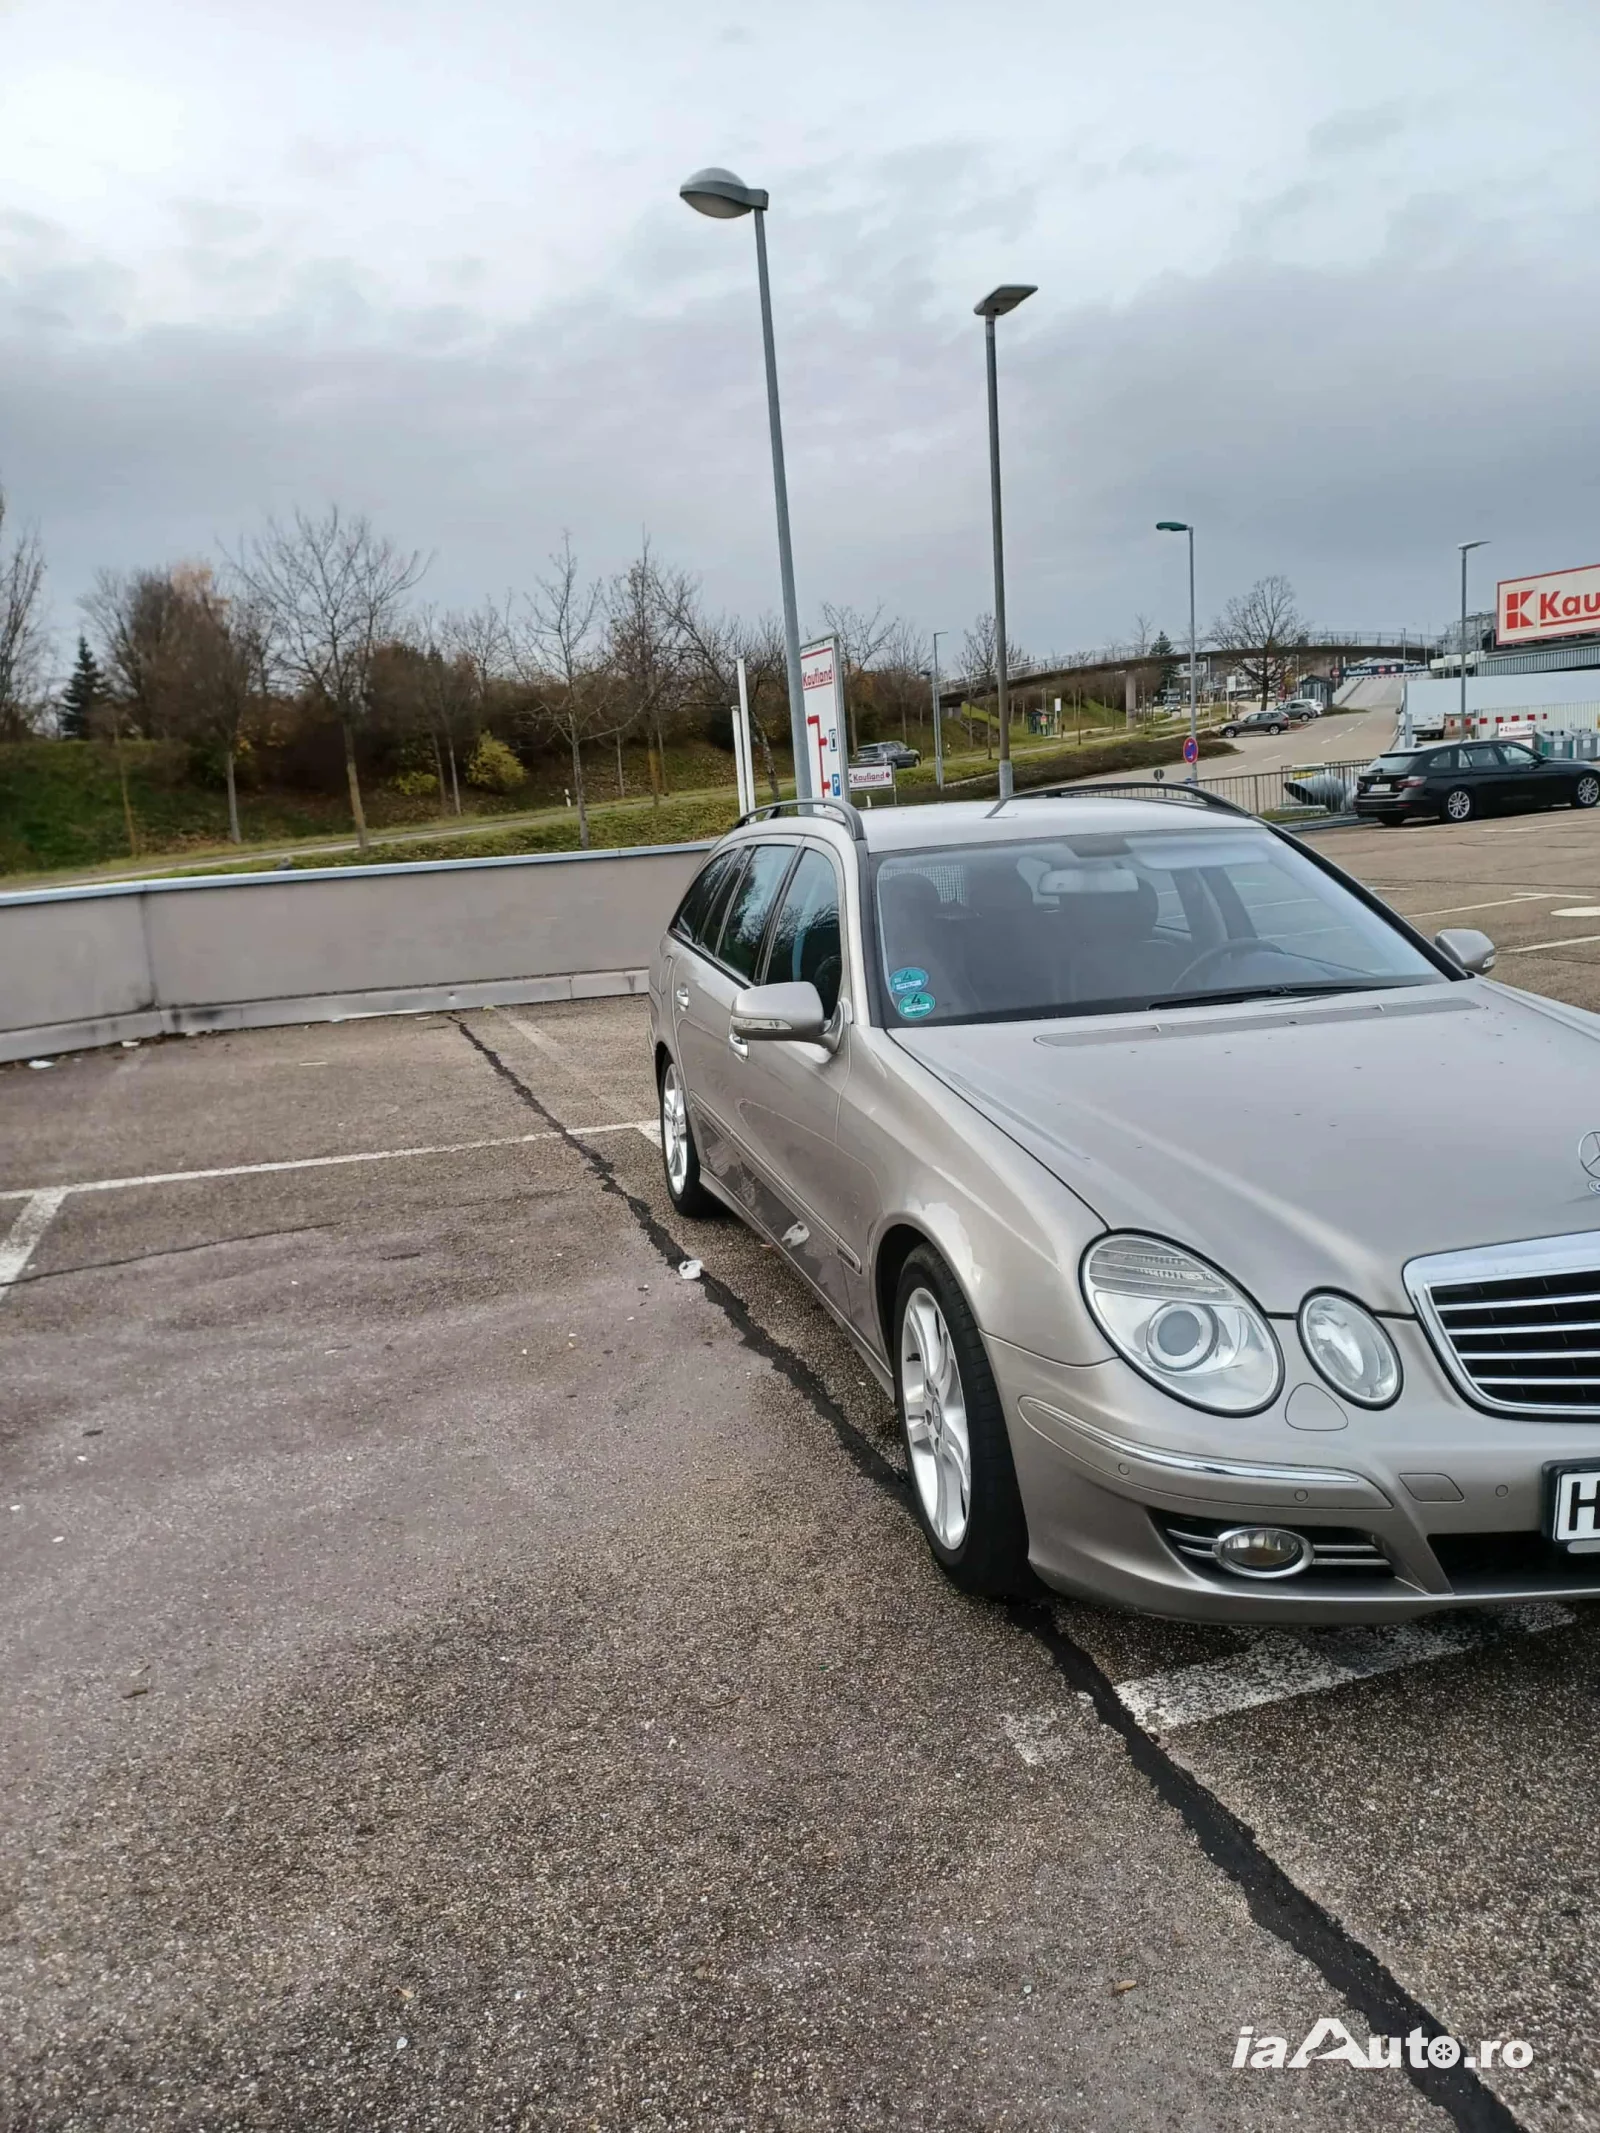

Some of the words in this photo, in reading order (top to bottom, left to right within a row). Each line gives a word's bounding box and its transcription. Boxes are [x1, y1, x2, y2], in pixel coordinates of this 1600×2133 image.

[1540, 590, 1600, 620] Kau
[802, 664, 833, 688] Kaufland
[1345, 667, 1372, 676] Ausfahrt
[853, 772, 885, 782] Kaufland
[903, 971, 912, 981] 4
[911, 994, 921, 1005] 4
[1568, 1480, 1600, 1531] H
